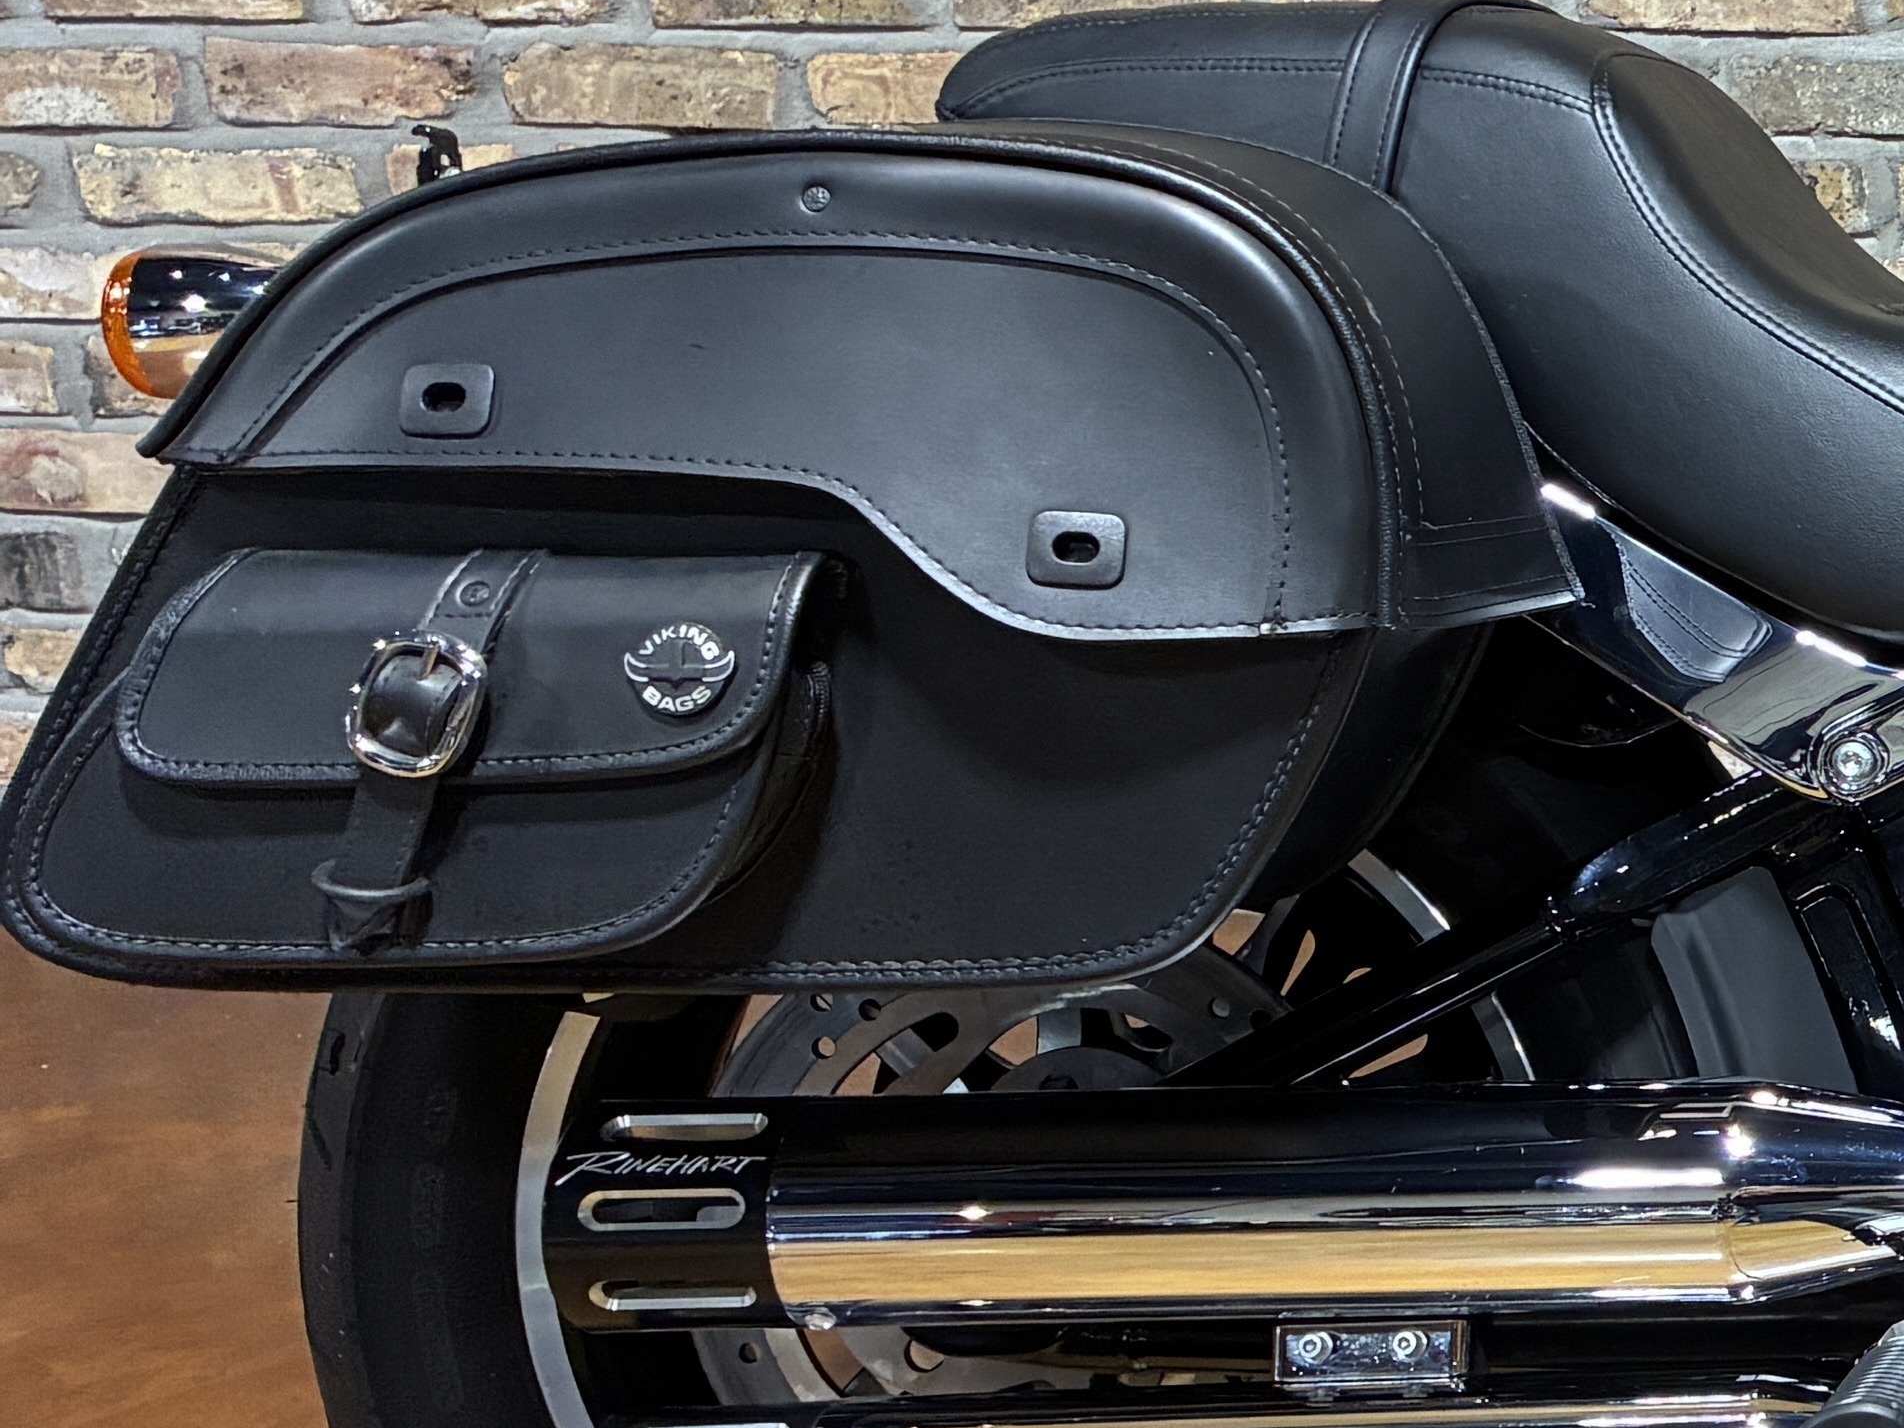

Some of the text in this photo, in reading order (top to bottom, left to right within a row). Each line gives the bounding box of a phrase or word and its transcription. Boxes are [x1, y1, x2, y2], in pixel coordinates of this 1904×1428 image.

[638, 624, 720, 662] VIKING
[641, 684, 714, 714] BAGS
[554, 1150, 768, 1186] RINEHART
